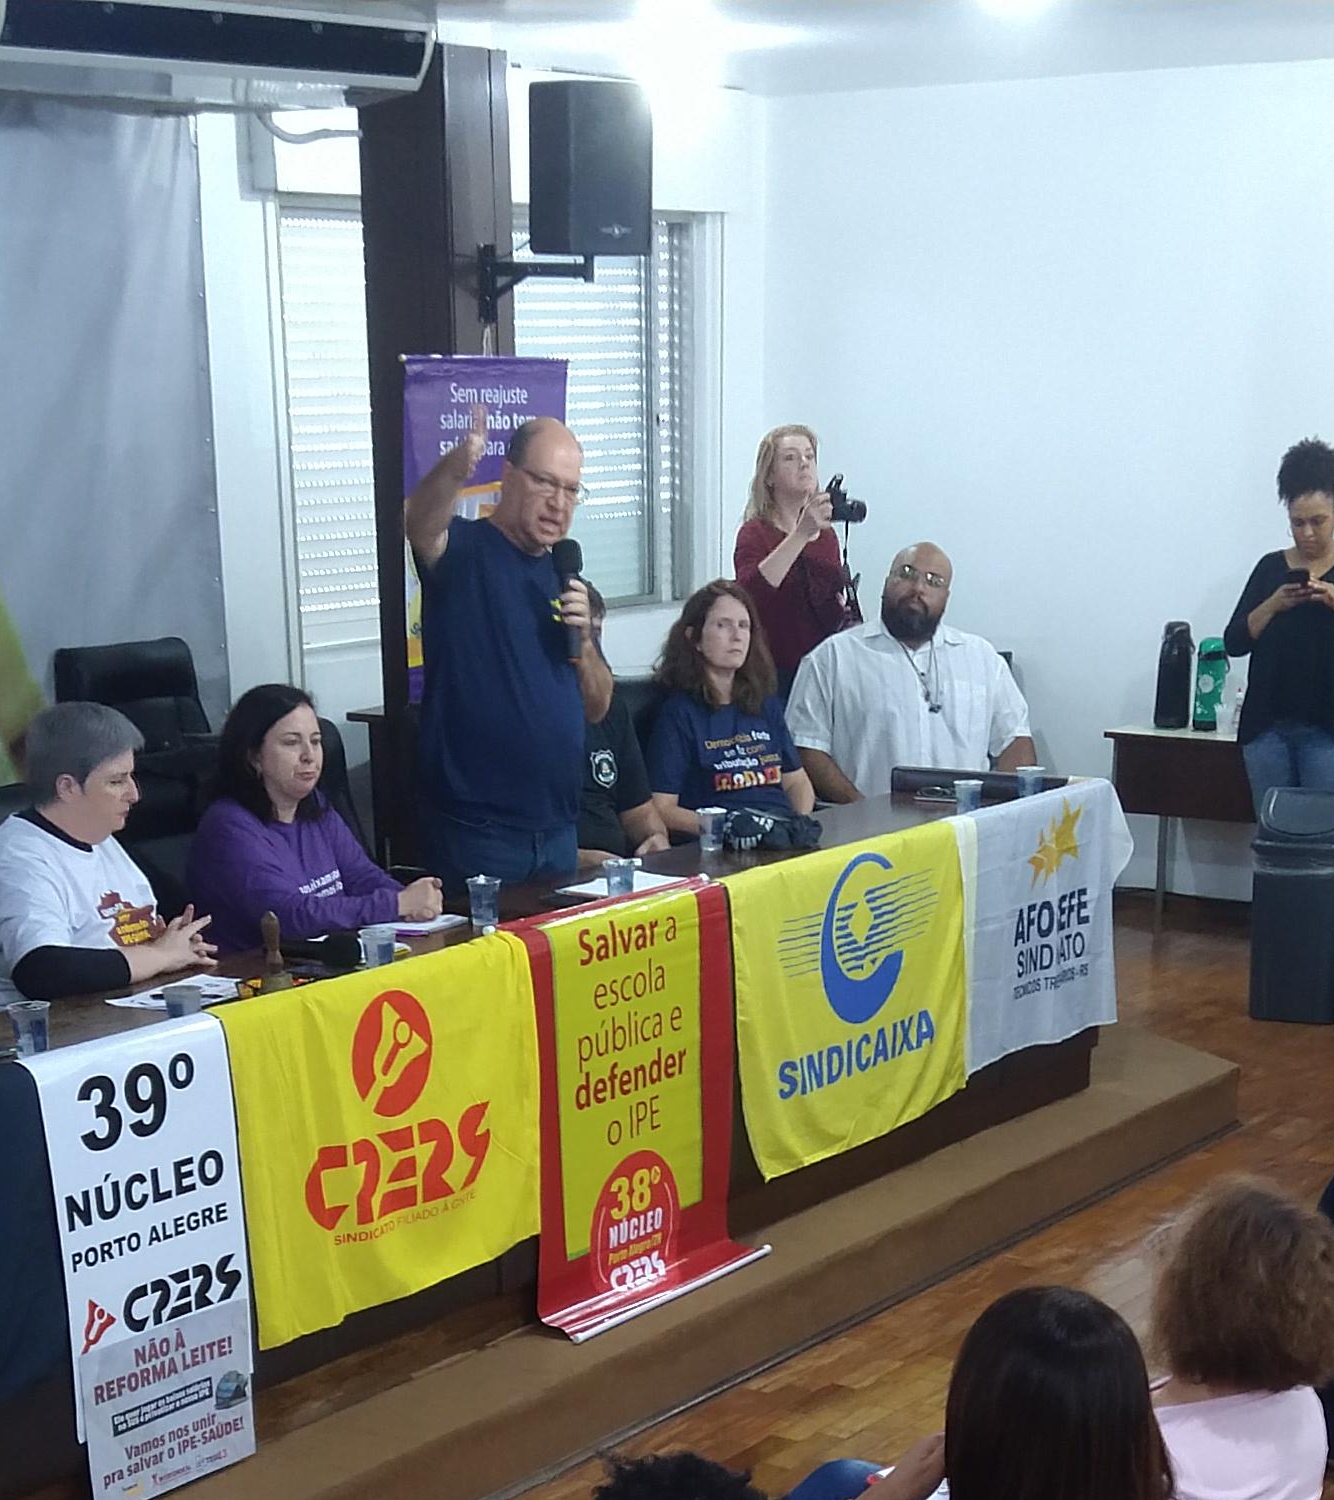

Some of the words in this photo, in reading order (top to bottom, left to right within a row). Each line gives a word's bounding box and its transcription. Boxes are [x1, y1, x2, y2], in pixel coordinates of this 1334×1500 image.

[440, 410, 478, 430] salari
[486, 411, 510, 430] não
[450, 382, 478, 404] Sem
[480, 385, 528, 408] reajuste
[578, 919, 659, 967] Salvar
[665, 916, 677, 942] a
[1014, 887, 1090, 947] AFOEFE
[593, 958, 666, 1010] escola
[1017, 931, 1086, 978] SINDATO
[578, 1011, 663, 1073] pública
[670, 1005, 683, 1032] e
[779, 1009, 935, 1100] SINDICAIXA
[77, 1053, 194, 1151] 39º
[575, 1047, 687, 1111] defender
[607, 1120, 622, 1146] o
[629, 1095, 661, 1139] IPE
[65, 1150, 224, 1232] NÚCLEO
[305, 1100, 491, 1231] CPERS
[71, 1233, 141, 1273] PORTO
[148, 1203, 228, 1246] ALEGRE
[333, 1221, 396, 1247] SINDICATO
[397, 1204, 439, 1227] FILIADO
[608, 1207, 663, 1249] NÚCLEO
[123, 1253, 242, 1333] CPERS
[93, 1358, 178, 1406] REFORMA
[182, 1335, 233, 1371] LEITE!
[134, 1338, 171, 1367] NÃO
[103, 1469, 124, 1490] pra
[127, 1451, 164, 1478] salvar
[167, 1447, 175, 1460] o
[178, 1416, 244, 1455] IPE-SAÚDE!
[125, 1434, 165, 1460] Vamos
[168, 1425, 189, 1443] nos
[192, 1413, 217, 1438] unir
